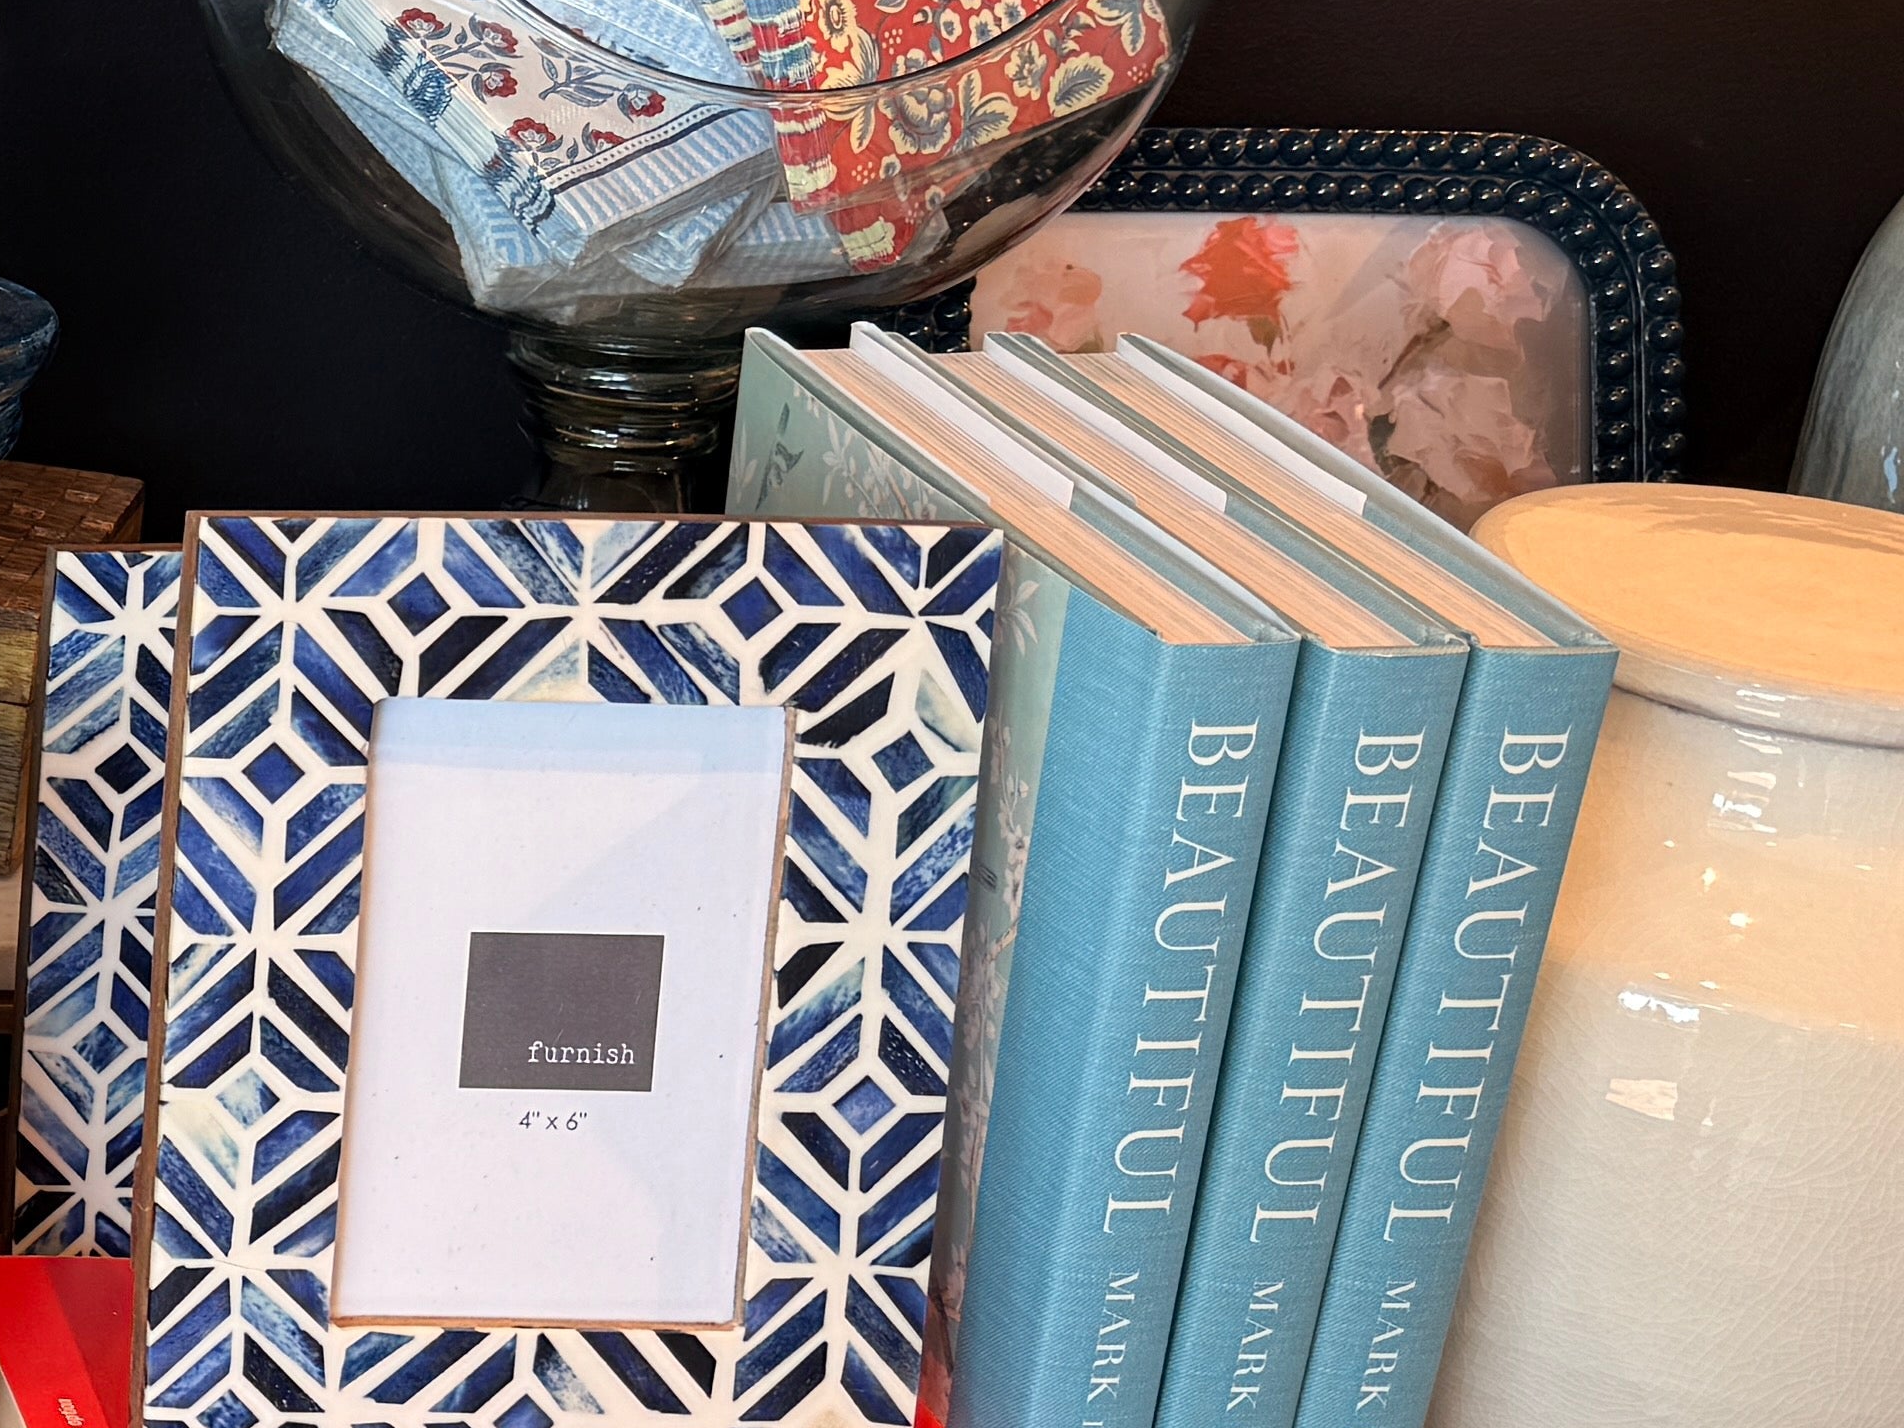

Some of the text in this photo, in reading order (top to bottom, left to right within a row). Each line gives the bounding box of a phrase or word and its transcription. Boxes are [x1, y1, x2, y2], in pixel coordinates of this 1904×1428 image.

[1103, 716, 1260, 1234] BEAUTIFUL
[1250, 725, 1426, 1244] BEAUTIFUL
[1383, 723, 1573, 1242] BEAUTIFUL
[527, 1041, 635, 1064] furnish
[519, 1111, 588, 1130] 4" x 6"
[1087, 1268, 1140, 1403] MARK
[1226, 1277, 1286, 1411] MARK
[1356, 1277, 1417, 1411] MARK
